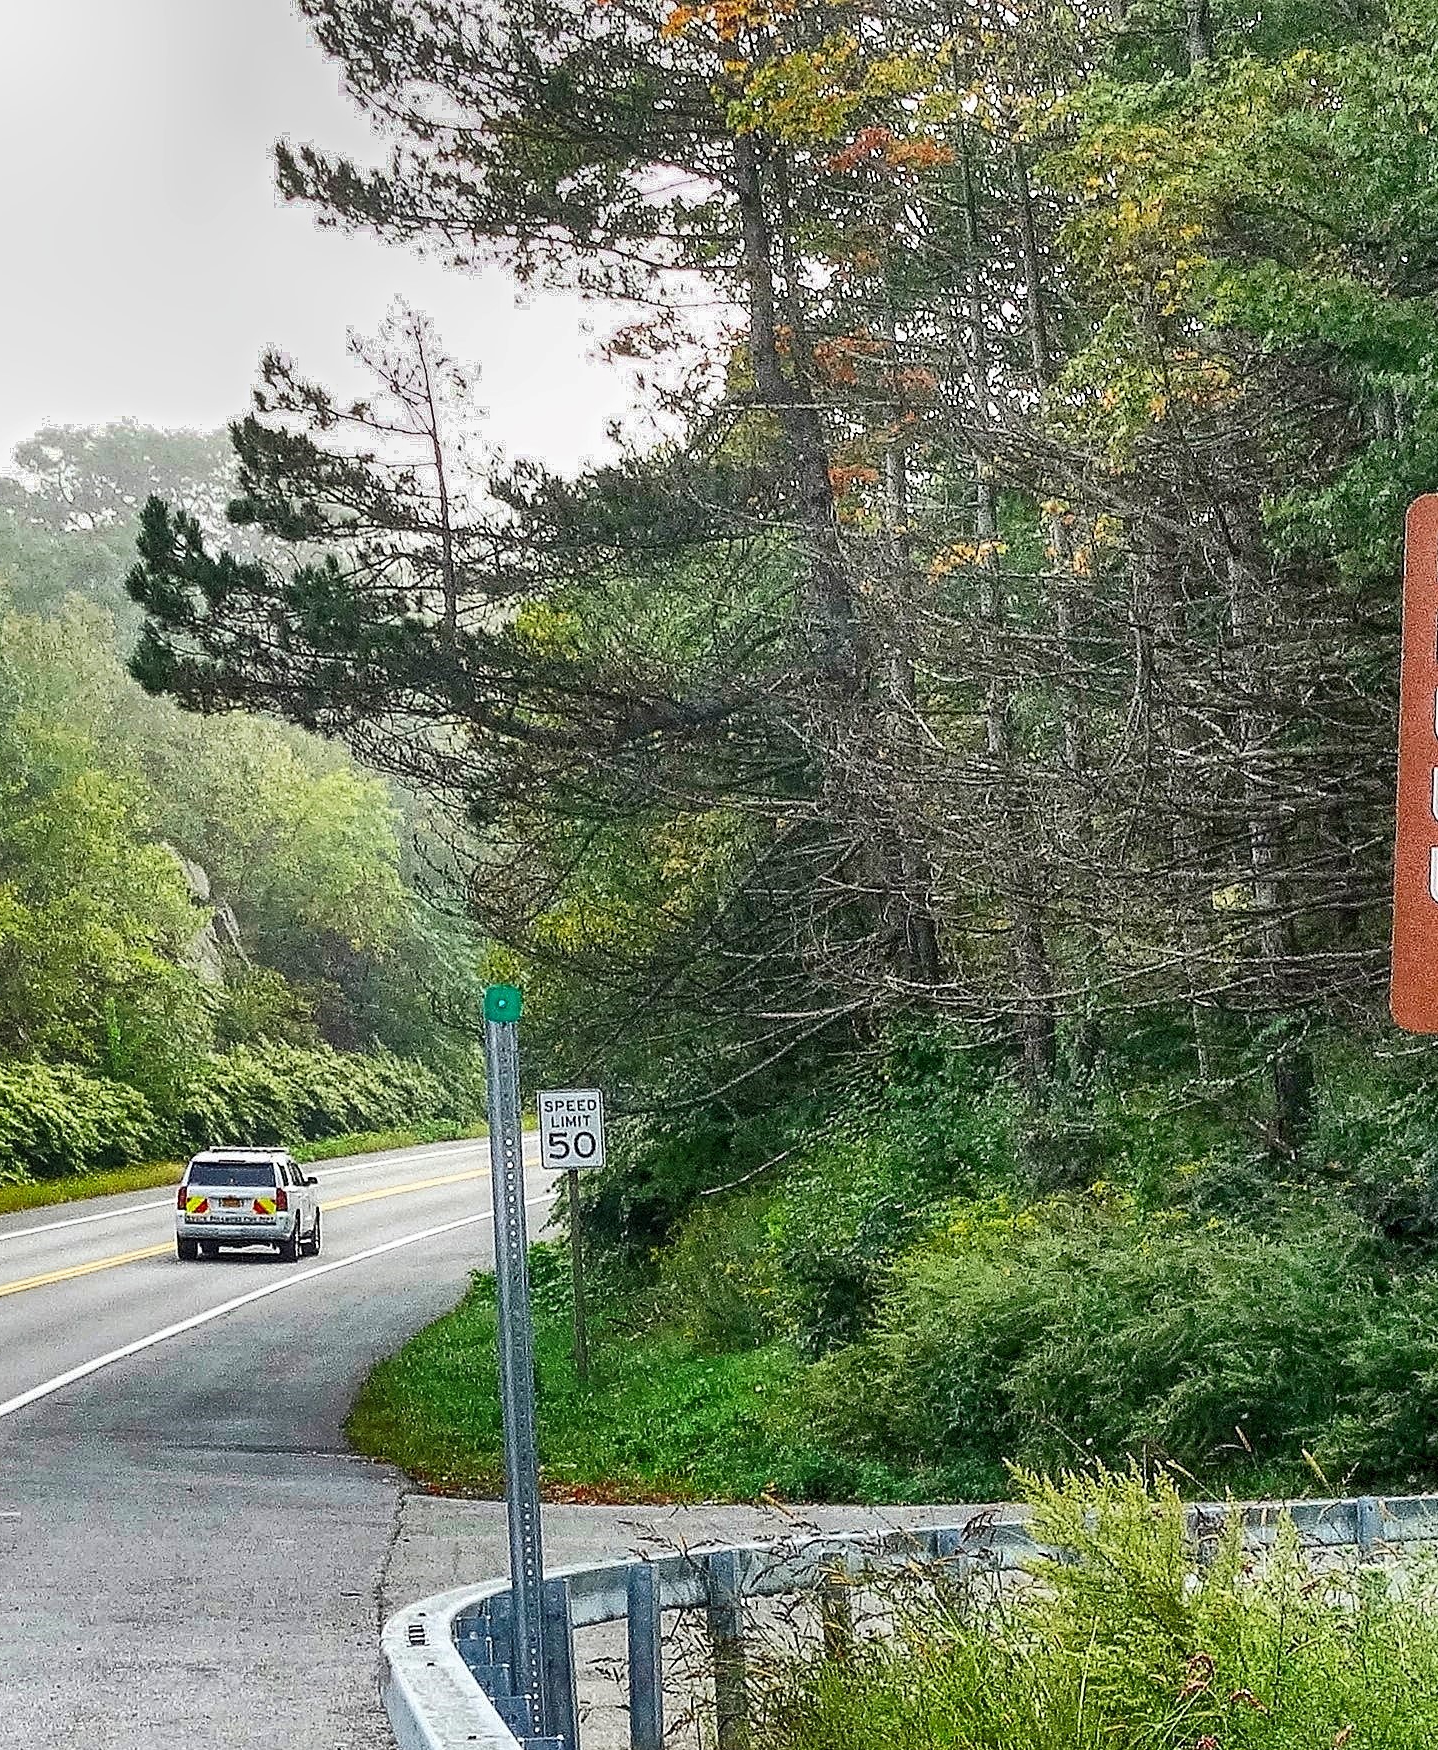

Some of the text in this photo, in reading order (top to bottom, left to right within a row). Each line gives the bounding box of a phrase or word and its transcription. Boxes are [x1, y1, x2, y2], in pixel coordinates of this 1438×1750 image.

[544, 1099, 596, 1112] SPEED
[551, 1115, 591, 1128] LIMIT
[549, 1131, 596, 1159] 50
